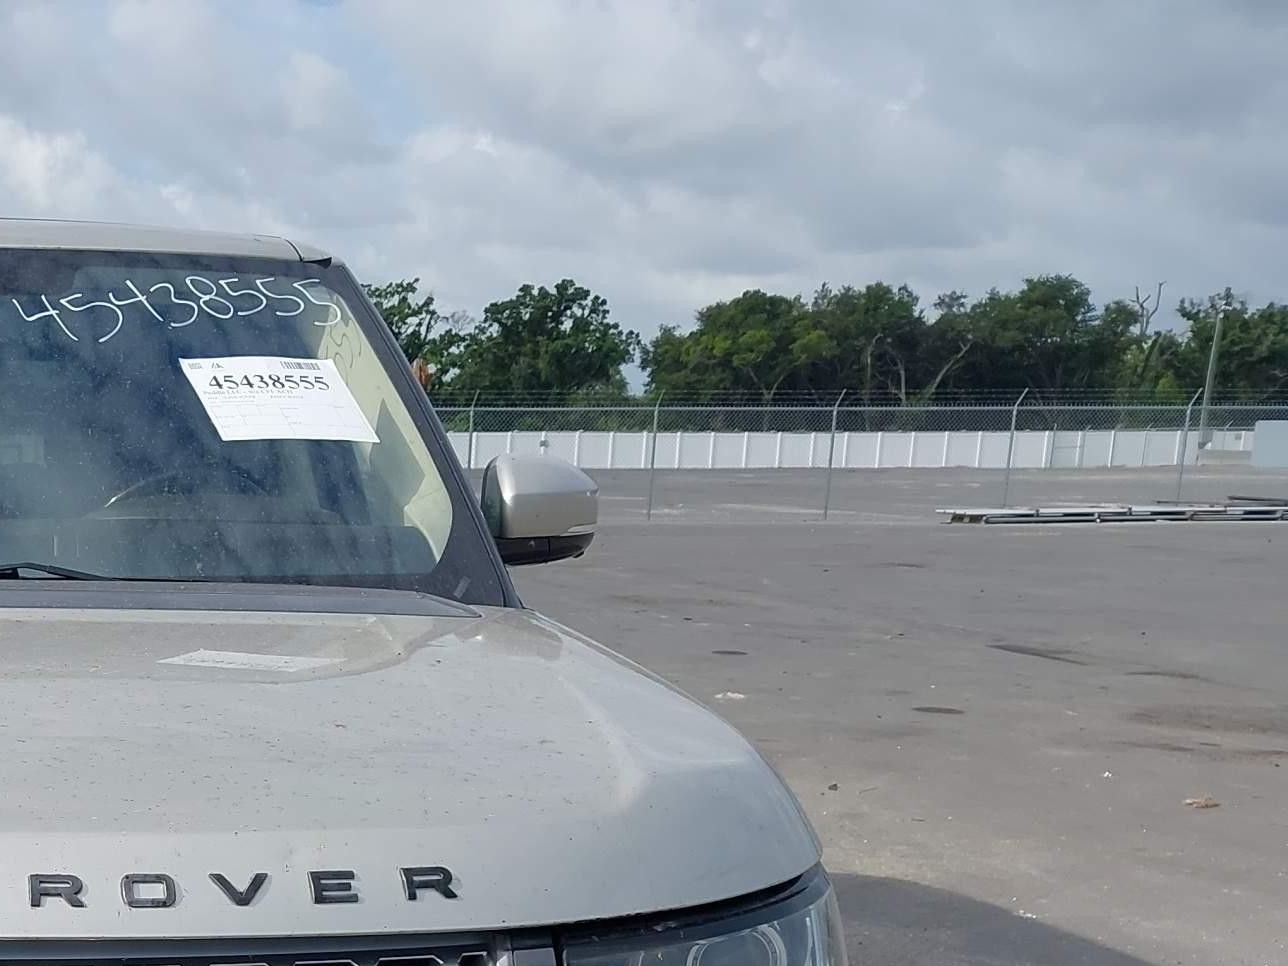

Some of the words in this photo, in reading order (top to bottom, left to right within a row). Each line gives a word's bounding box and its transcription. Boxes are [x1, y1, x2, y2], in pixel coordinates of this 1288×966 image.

[11, 275, 341, 344] 45438555
[208, 374, 330, 391] 45438555
[28, 864, 463, 908] ROVER
